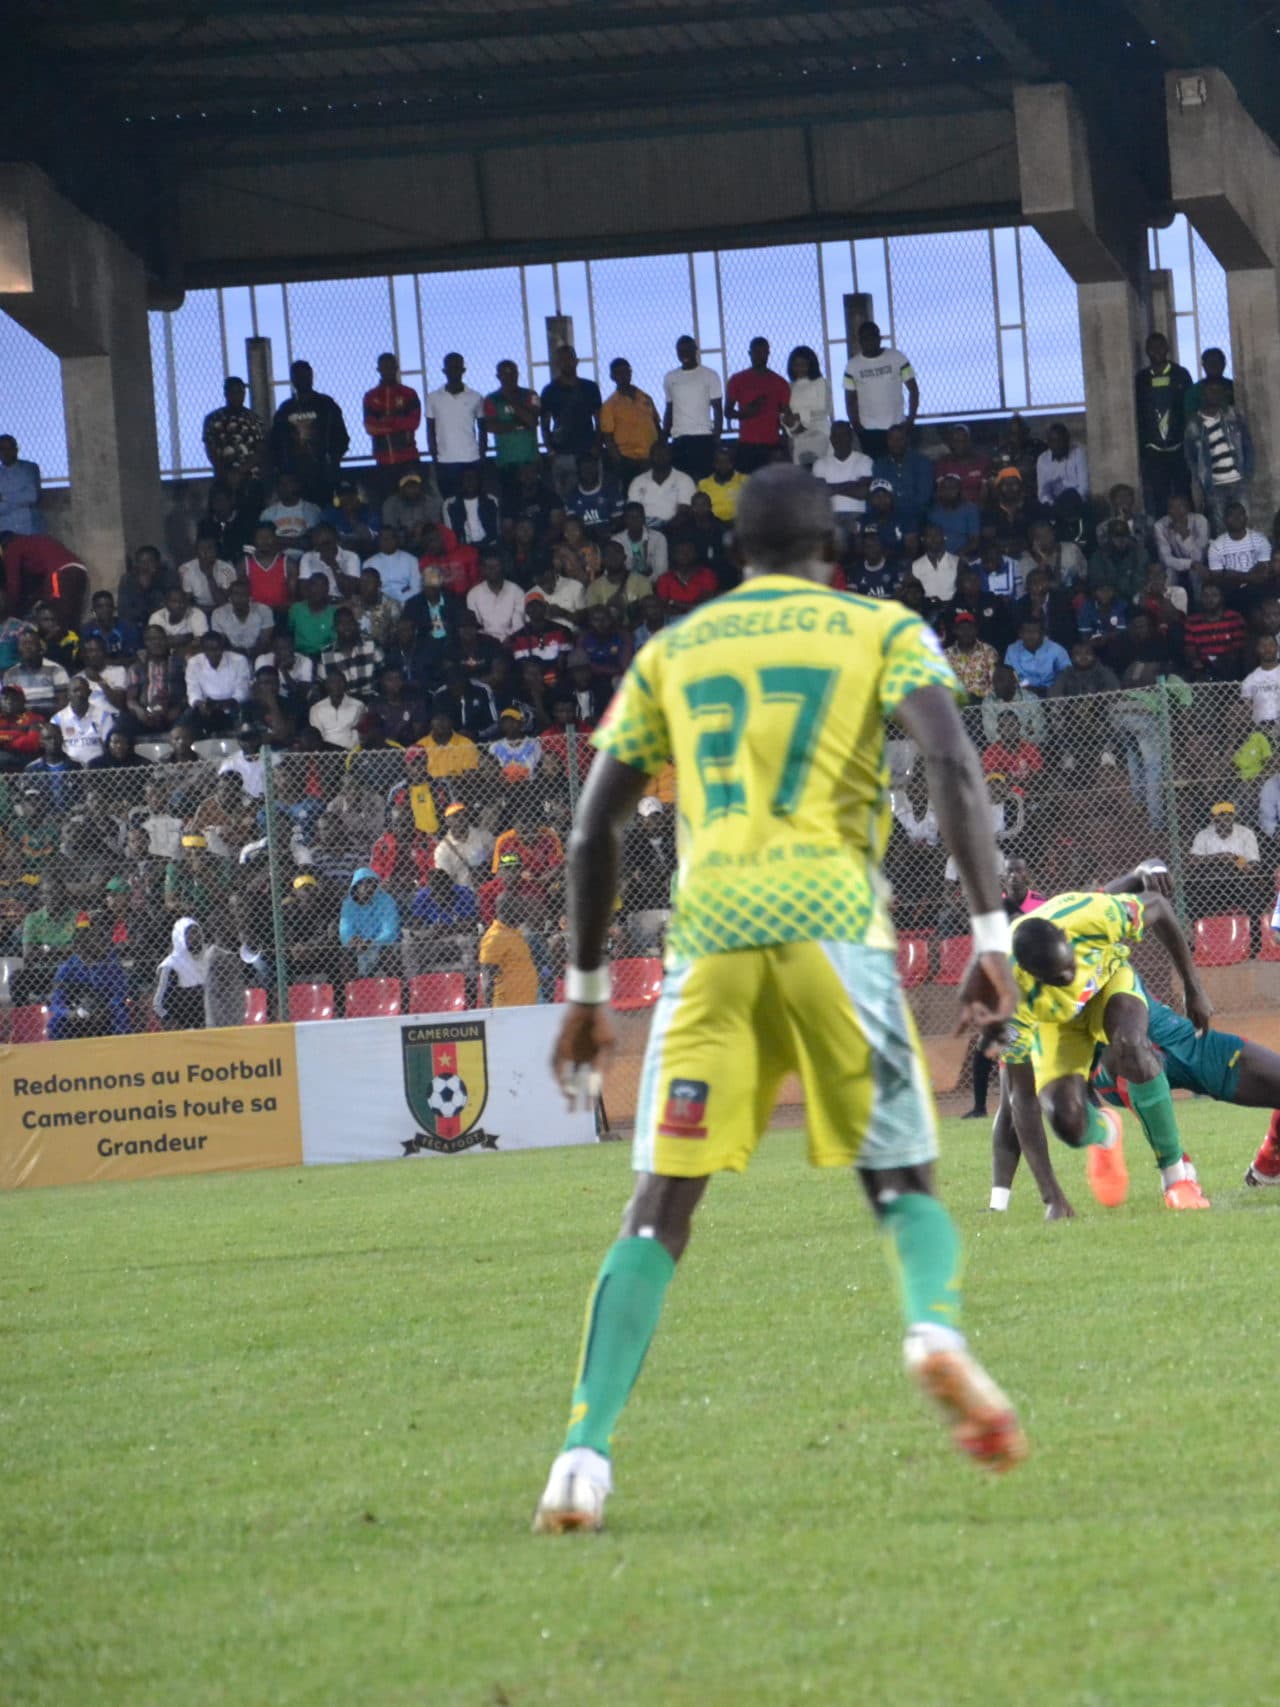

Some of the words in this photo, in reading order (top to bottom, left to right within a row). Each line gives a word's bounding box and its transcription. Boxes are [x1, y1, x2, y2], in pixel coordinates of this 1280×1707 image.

[681, 665, 842, 827] 27
[407, 1026, 479, 1041] CAMEROUN
[13, 1072, 146, 1096] Redonnons
[152, 1069, 180, 1086] au
[187, 1058, 282, 1084] Football
[22, 1099, 177, 1129] Camerounais
[183, 1096, 245, 1118] toute
[251, 1096, 277, 1113] sa
[97, 1133, 208, 1157] Grandeur
